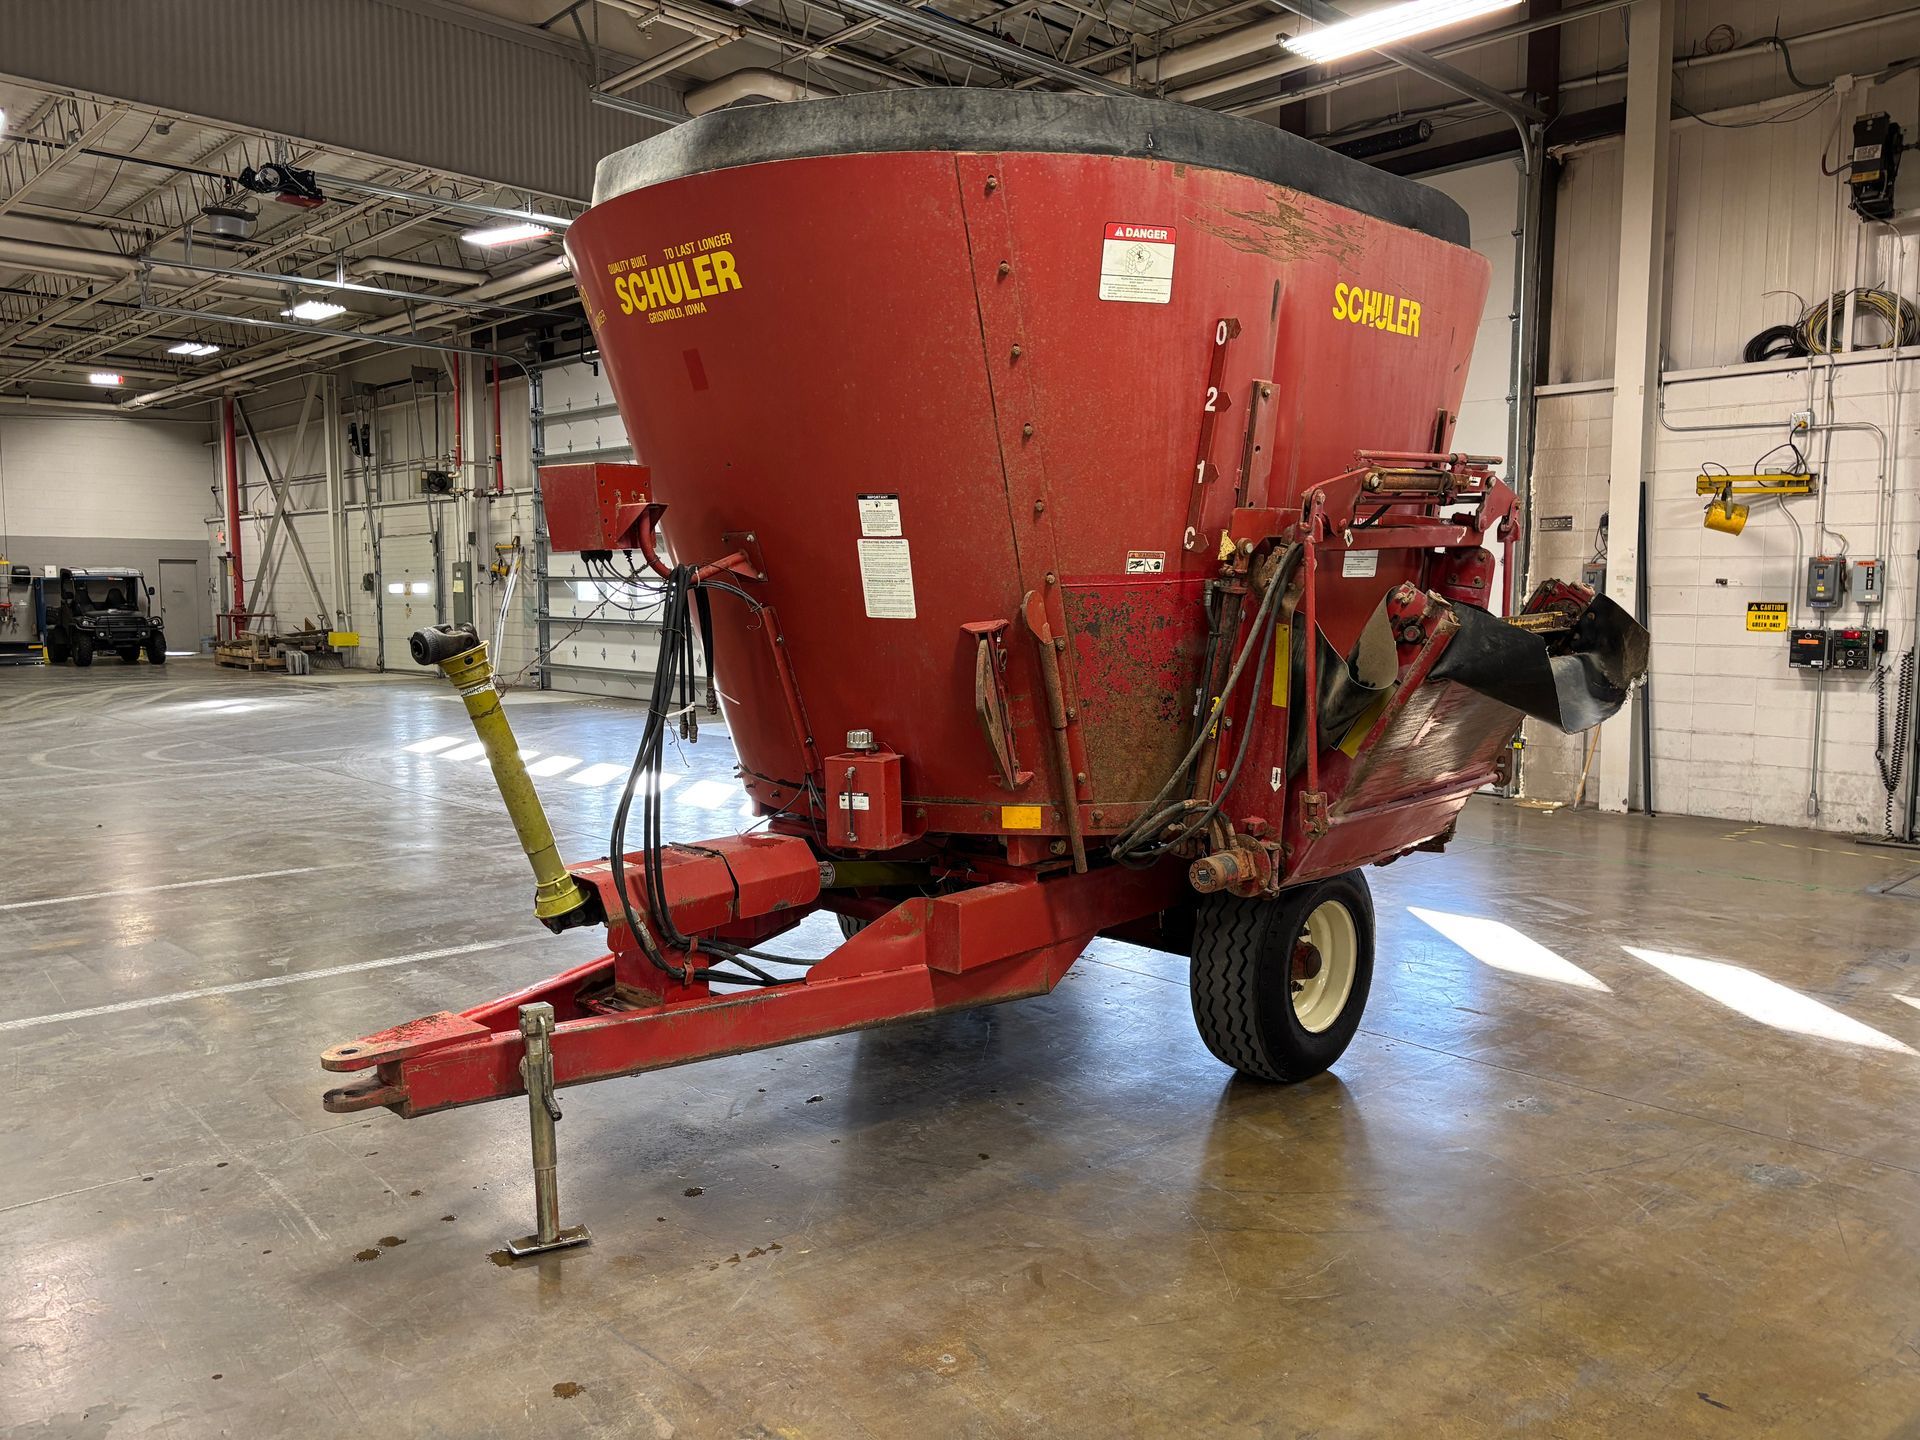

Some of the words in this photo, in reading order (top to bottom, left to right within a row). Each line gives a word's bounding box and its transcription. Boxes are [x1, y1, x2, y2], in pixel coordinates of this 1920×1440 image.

[1125, 227, 1168, 240] DANGER
[607, 259, 630, 275] QUALITY
[630, 254, 648, 269] BUILT
[663, 247, 675, 260] TO
[675, 241, 695, 257] LAST
[697, 232, 733, 252] LONGER
[615, 250, 743, 315] SCHULER
[648, 306, 685, 324] GRISWOLD,
[684, 302, 708, 316] IOWA
[1332, 282, 1421, 338] SCHULER
[1204, 386, 1218, 412] 2
[1197, 460, 1206, 484] 1
[1184, 526, 1196, 550] C
